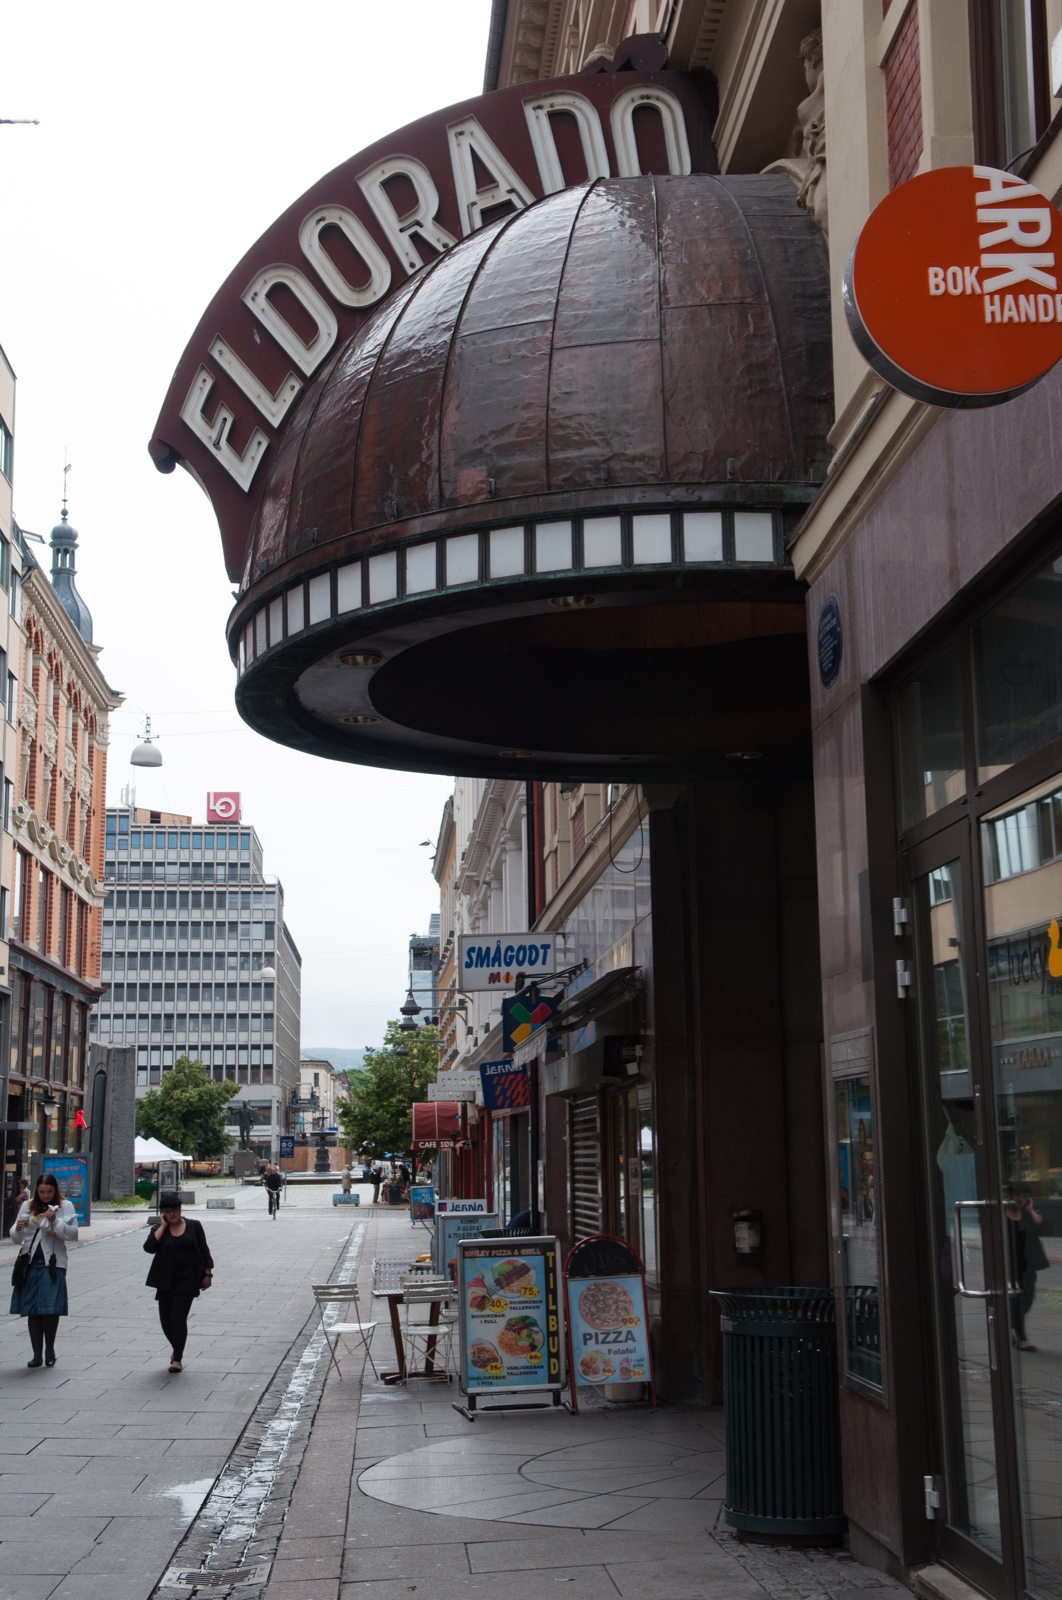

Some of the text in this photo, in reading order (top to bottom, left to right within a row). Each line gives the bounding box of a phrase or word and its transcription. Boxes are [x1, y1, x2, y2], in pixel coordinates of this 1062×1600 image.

[973, 165, 1057, 294] ARK
[179, 84, 692, 494] ELDORADO
[928, 266, 983, 296] BOK
[464, 940, 552, 969] SMÅGODT
[1006, 931, 1048, 995] lucky
[440, 1140, 455, 1148] SØR
[464, 1249, 490, 1257] SMILEY
[522, 1287, 540, 1296] 75,-
[489, 1300, 508, 1309] 40,-
[546, 1252, 559, 1375] TILBUD
[582, 1330, 637, 1346] PIZZA
[607, 1347, 637, 1356] Falafel
